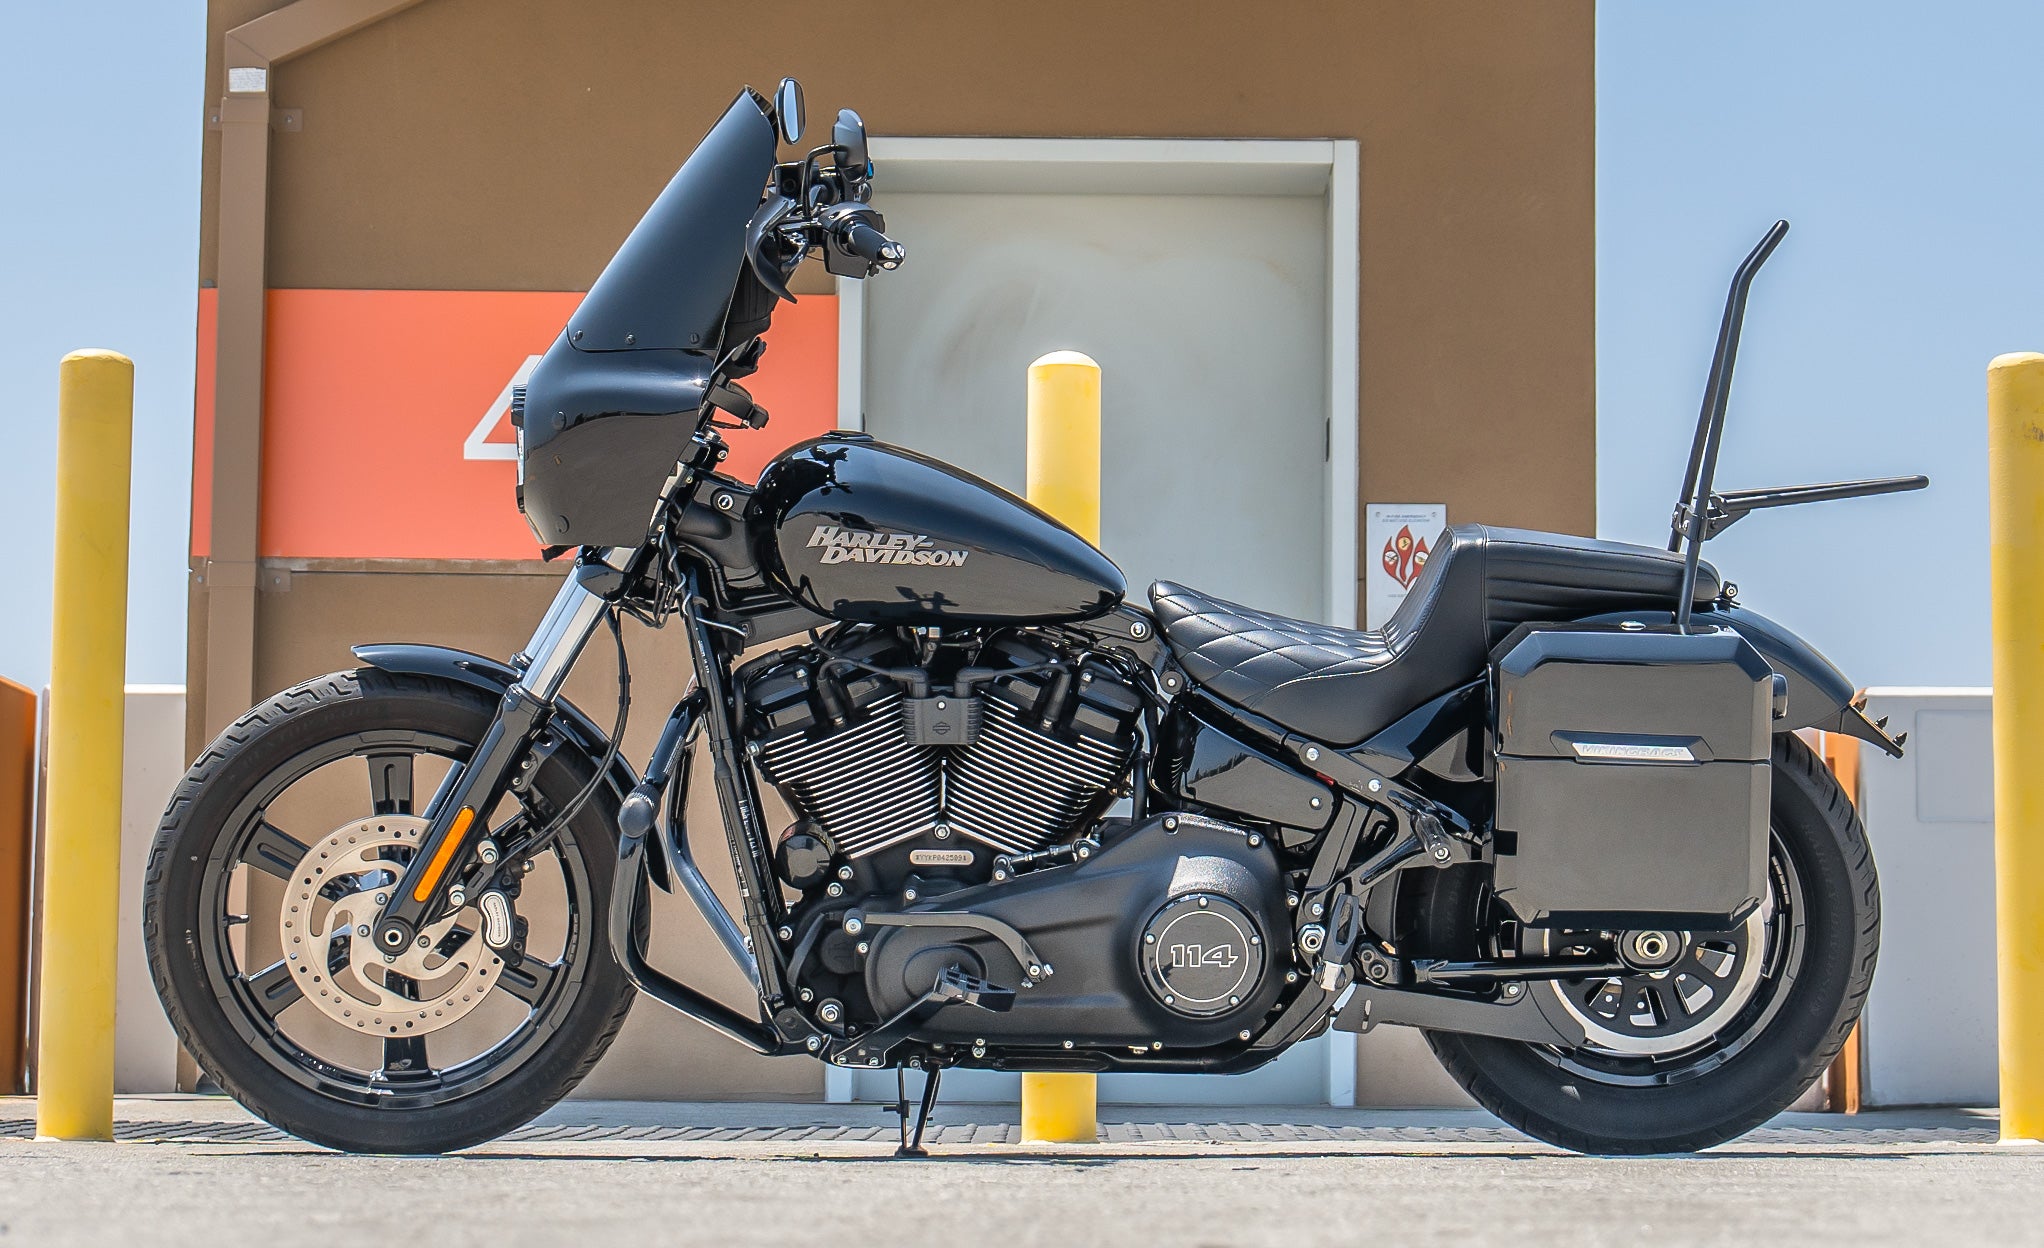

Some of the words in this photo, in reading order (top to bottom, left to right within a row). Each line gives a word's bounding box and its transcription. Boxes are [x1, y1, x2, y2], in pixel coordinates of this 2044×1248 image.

[463, 354, 544, 460] 4
[819, 546, 969, 567] DAVIDSON
[1170, 944, 1239, 968] 114
